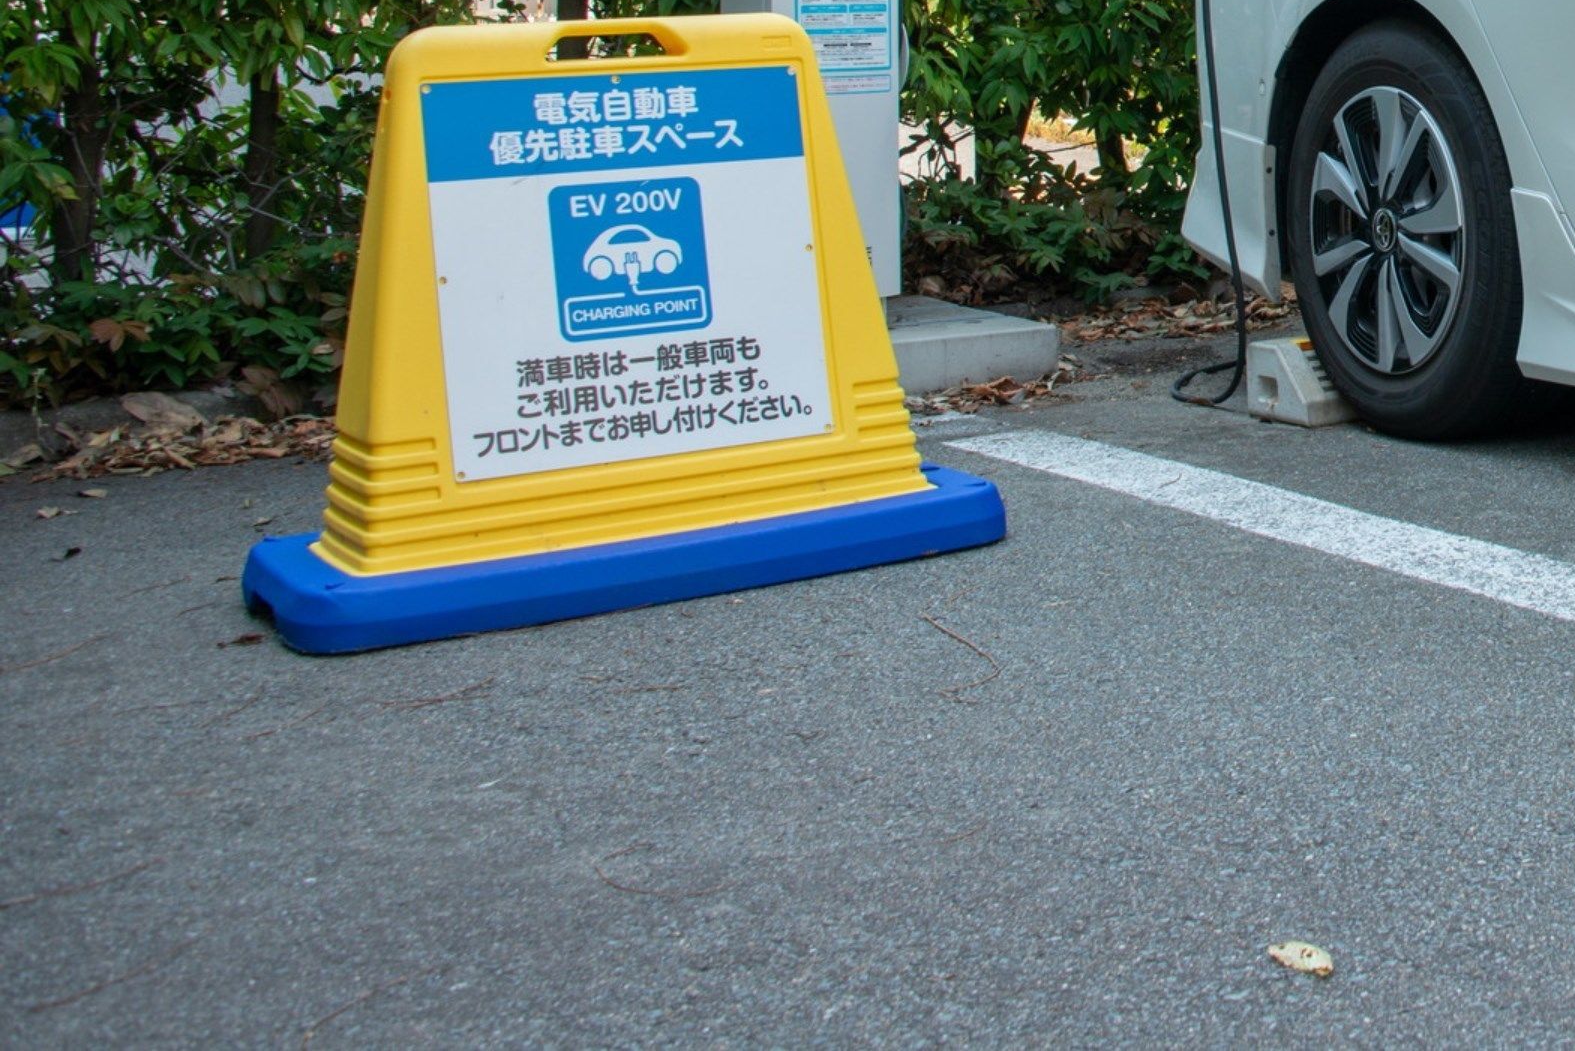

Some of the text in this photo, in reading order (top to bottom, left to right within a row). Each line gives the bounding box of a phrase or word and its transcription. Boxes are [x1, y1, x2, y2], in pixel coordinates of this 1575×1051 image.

[534, 85, 699, 125] 電気自動車
[490, 119, 744, 165] 優先駐車スペース
[570, 188, 681, 217] EV 200V
[572, 298, 698, 323] CHARGING POINT
[516, 336, 761, 388] 満車時は一般車両も
[517, 367, 769, 418] ご利用いただけます。
[473, 394, 813, 457] フロントまでお申し付けください。
